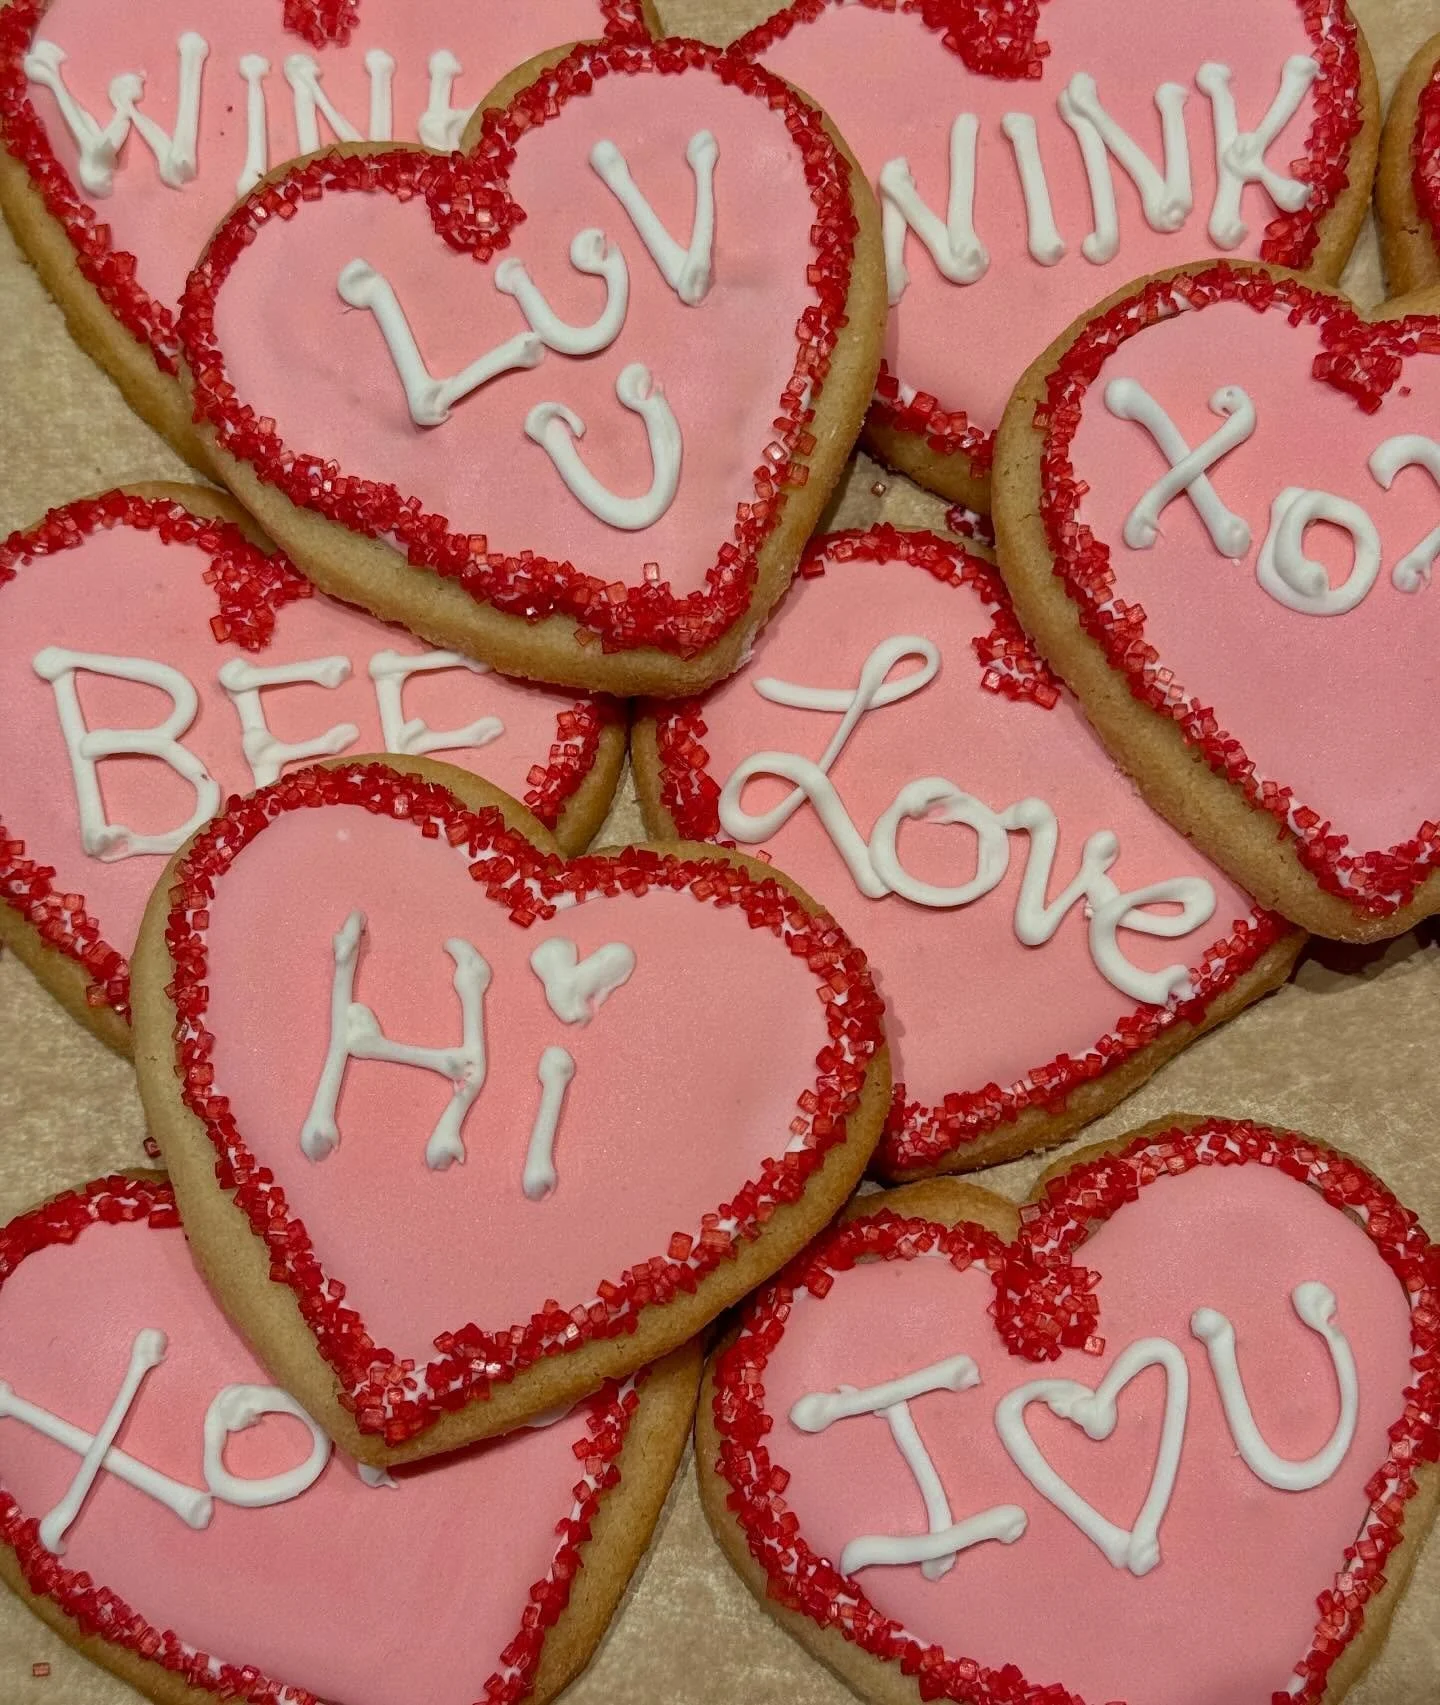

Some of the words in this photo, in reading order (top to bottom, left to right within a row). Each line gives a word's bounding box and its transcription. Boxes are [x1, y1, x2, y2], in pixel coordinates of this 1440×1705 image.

[337, 128, 719, 425] LUV
[524, 362, 683, 530] U
[717, 634, 1217, 1005] Love
[300, 910, 636, 1200] Hi
[0, 1327, 399, 1554] XO
[789, 1354, 1028, 1581] I
[1190, 1280, 1359, 1492] U
